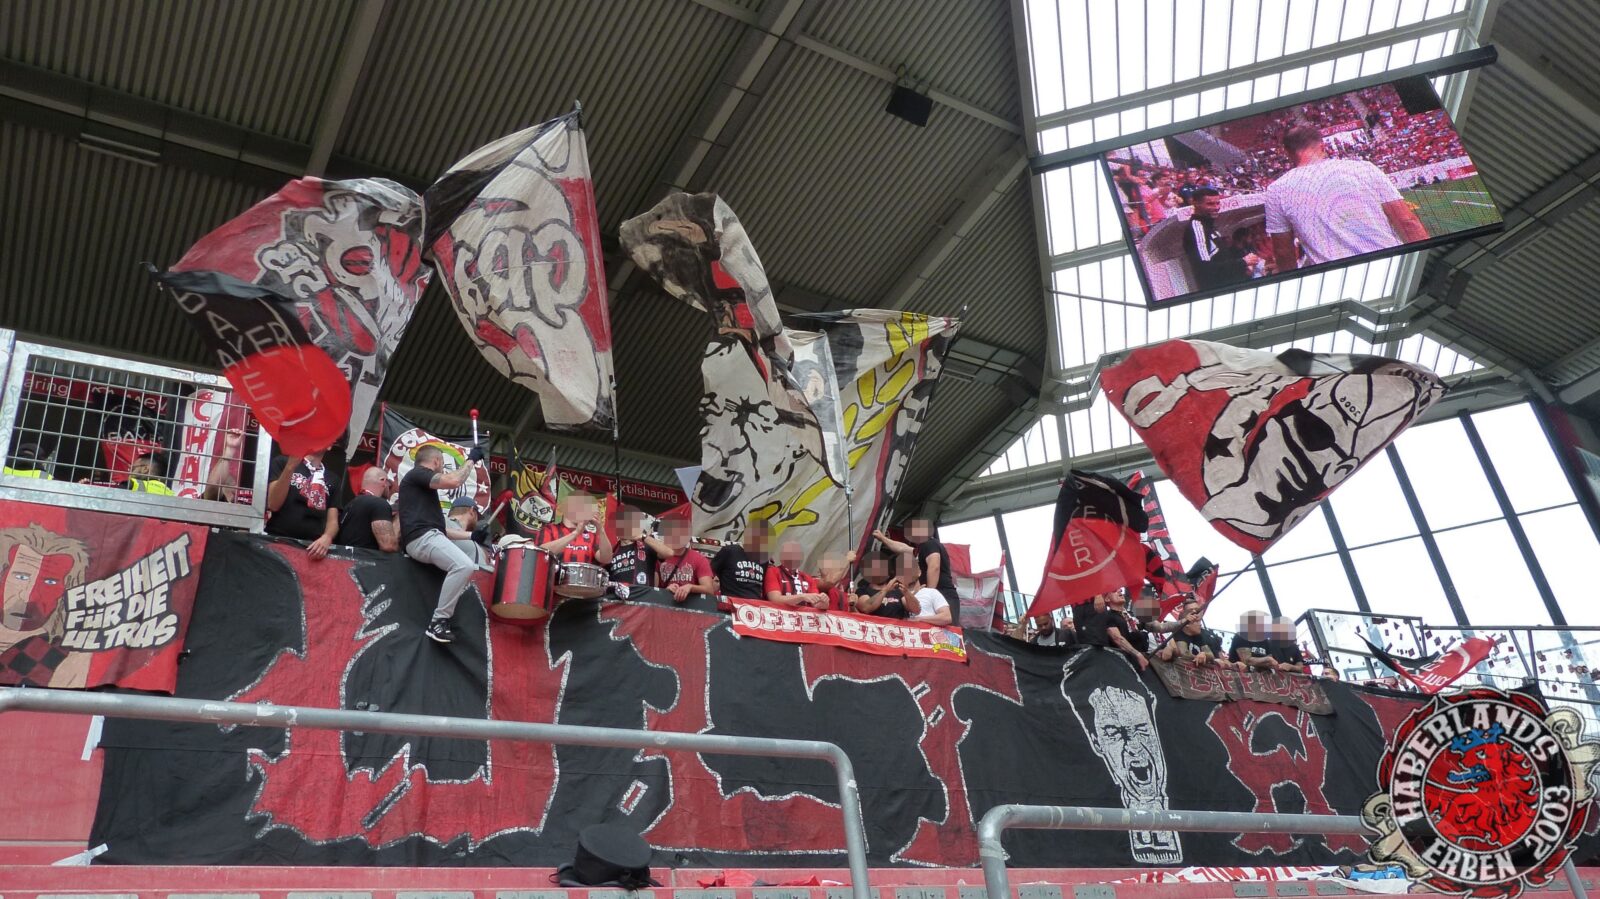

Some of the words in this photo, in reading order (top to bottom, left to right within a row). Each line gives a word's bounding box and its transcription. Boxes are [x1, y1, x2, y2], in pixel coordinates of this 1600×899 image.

[66, 534, 193, 609] FREIHEIT
[129, 585, 168, 619] DIE
[62, 613, 178, 651] ULTRAS
[737, 603, 924, 650] OFFENBACH
